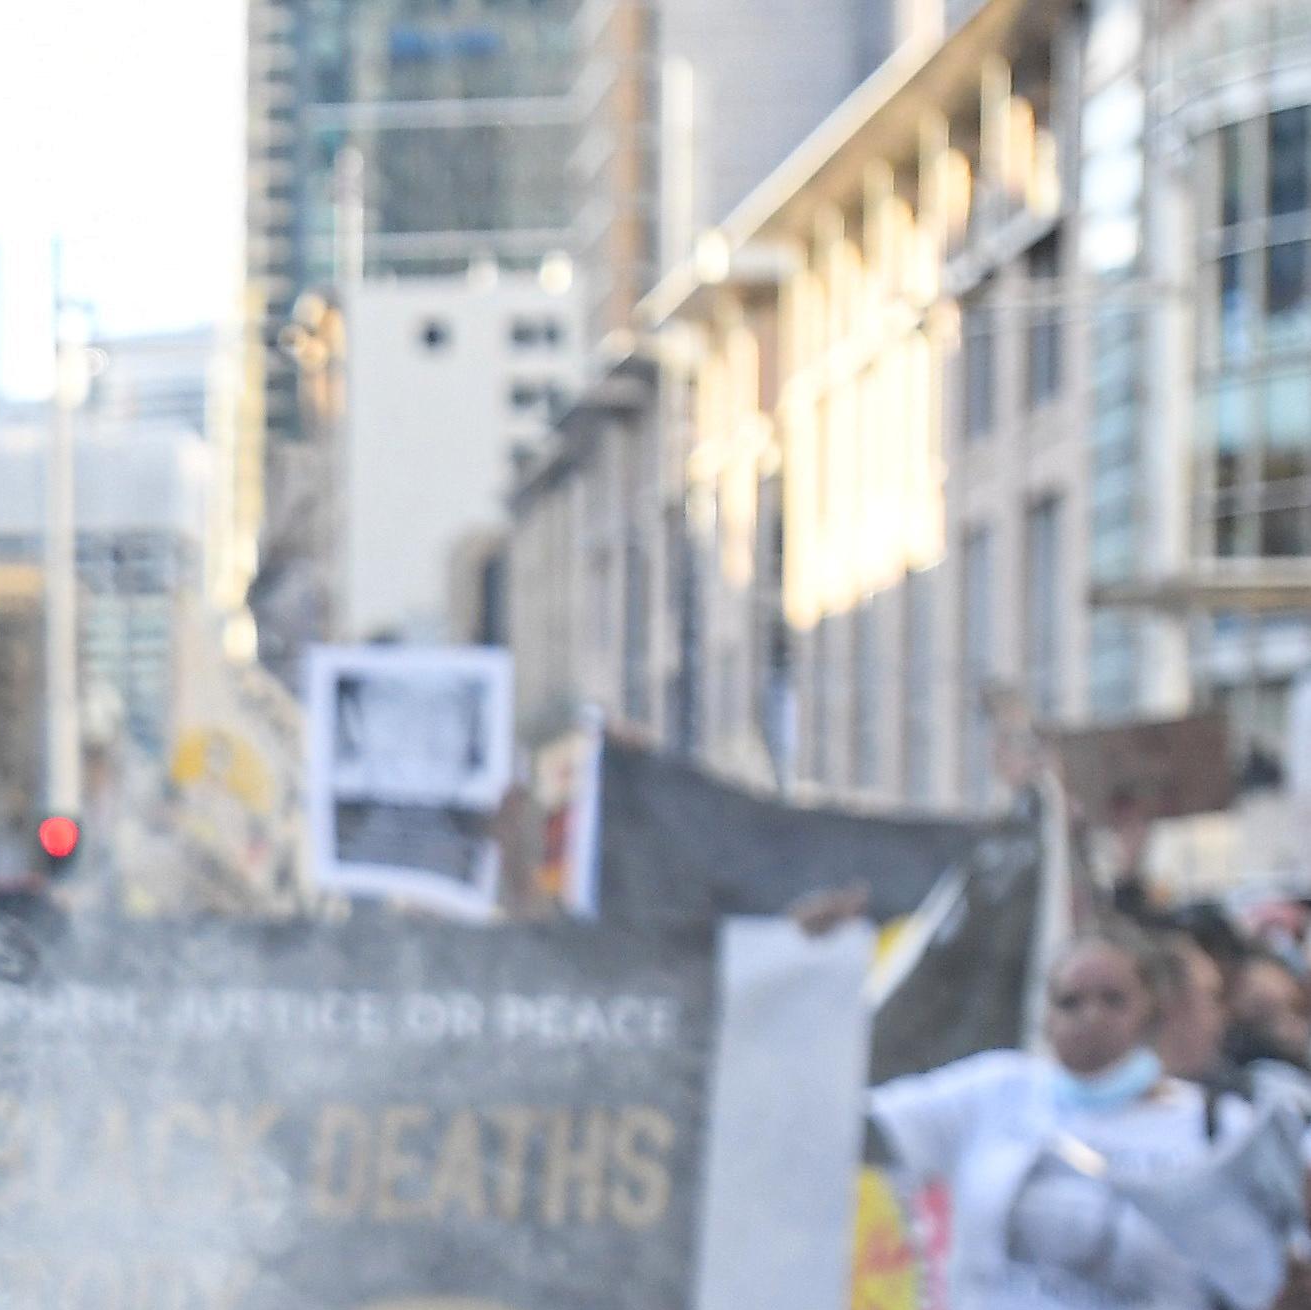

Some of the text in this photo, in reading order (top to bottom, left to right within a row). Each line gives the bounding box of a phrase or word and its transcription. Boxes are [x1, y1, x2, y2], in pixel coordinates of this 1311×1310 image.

[404, 989, 483, 1041] OR
[497, 991, 679, 1045] PEACE
[309, 1098, 676, 1233] DEATHS
